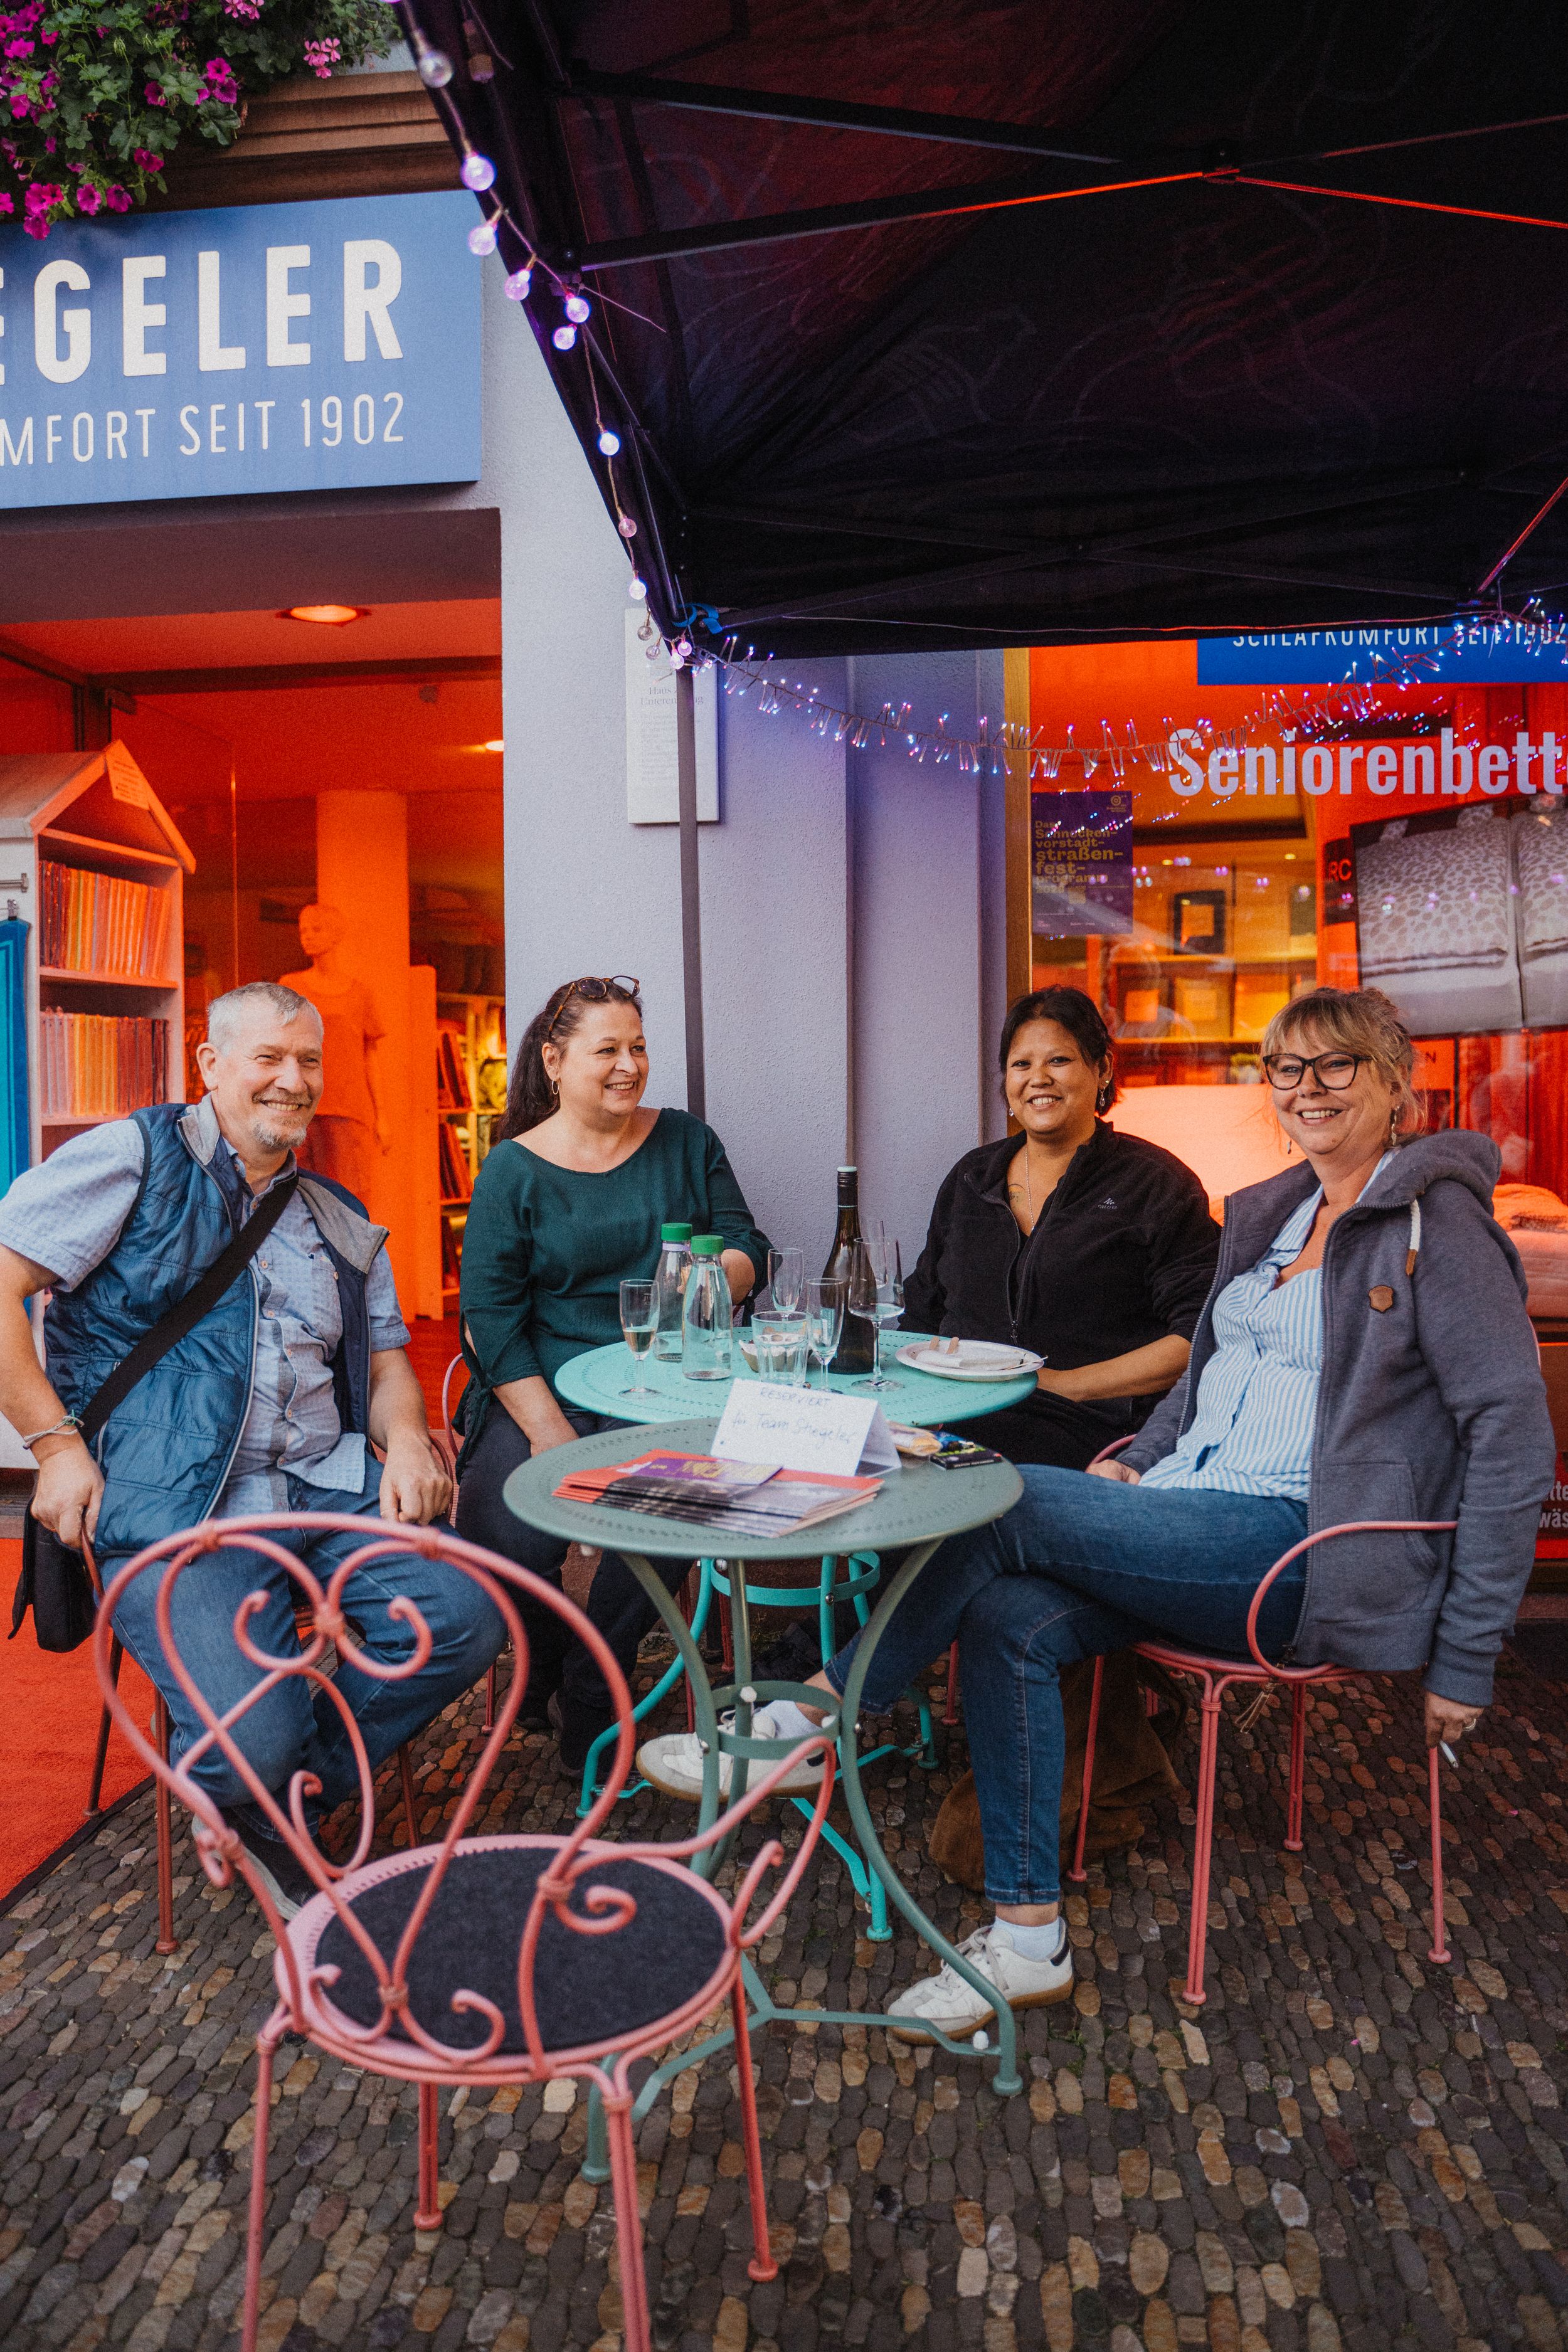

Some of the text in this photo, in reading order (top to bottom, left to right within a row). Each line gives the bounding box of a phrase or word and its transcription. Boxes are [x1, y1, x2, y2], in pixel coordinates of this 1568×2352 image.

[0, 239, 404, 385] GELER
[0, 391, 404, 467] MFORT SEIT 1902
[1168, 727, 1568, 797] Seniorenbett
[1036, 837, 1105, 847] vorstadt-
[1036, 847, 1124, 861] straßen-
[1036, 861, 1086, 874] fest-
[759, 1386, 832, 1406] RESERVIERT
[756, 1412, 790, 1429] Team
